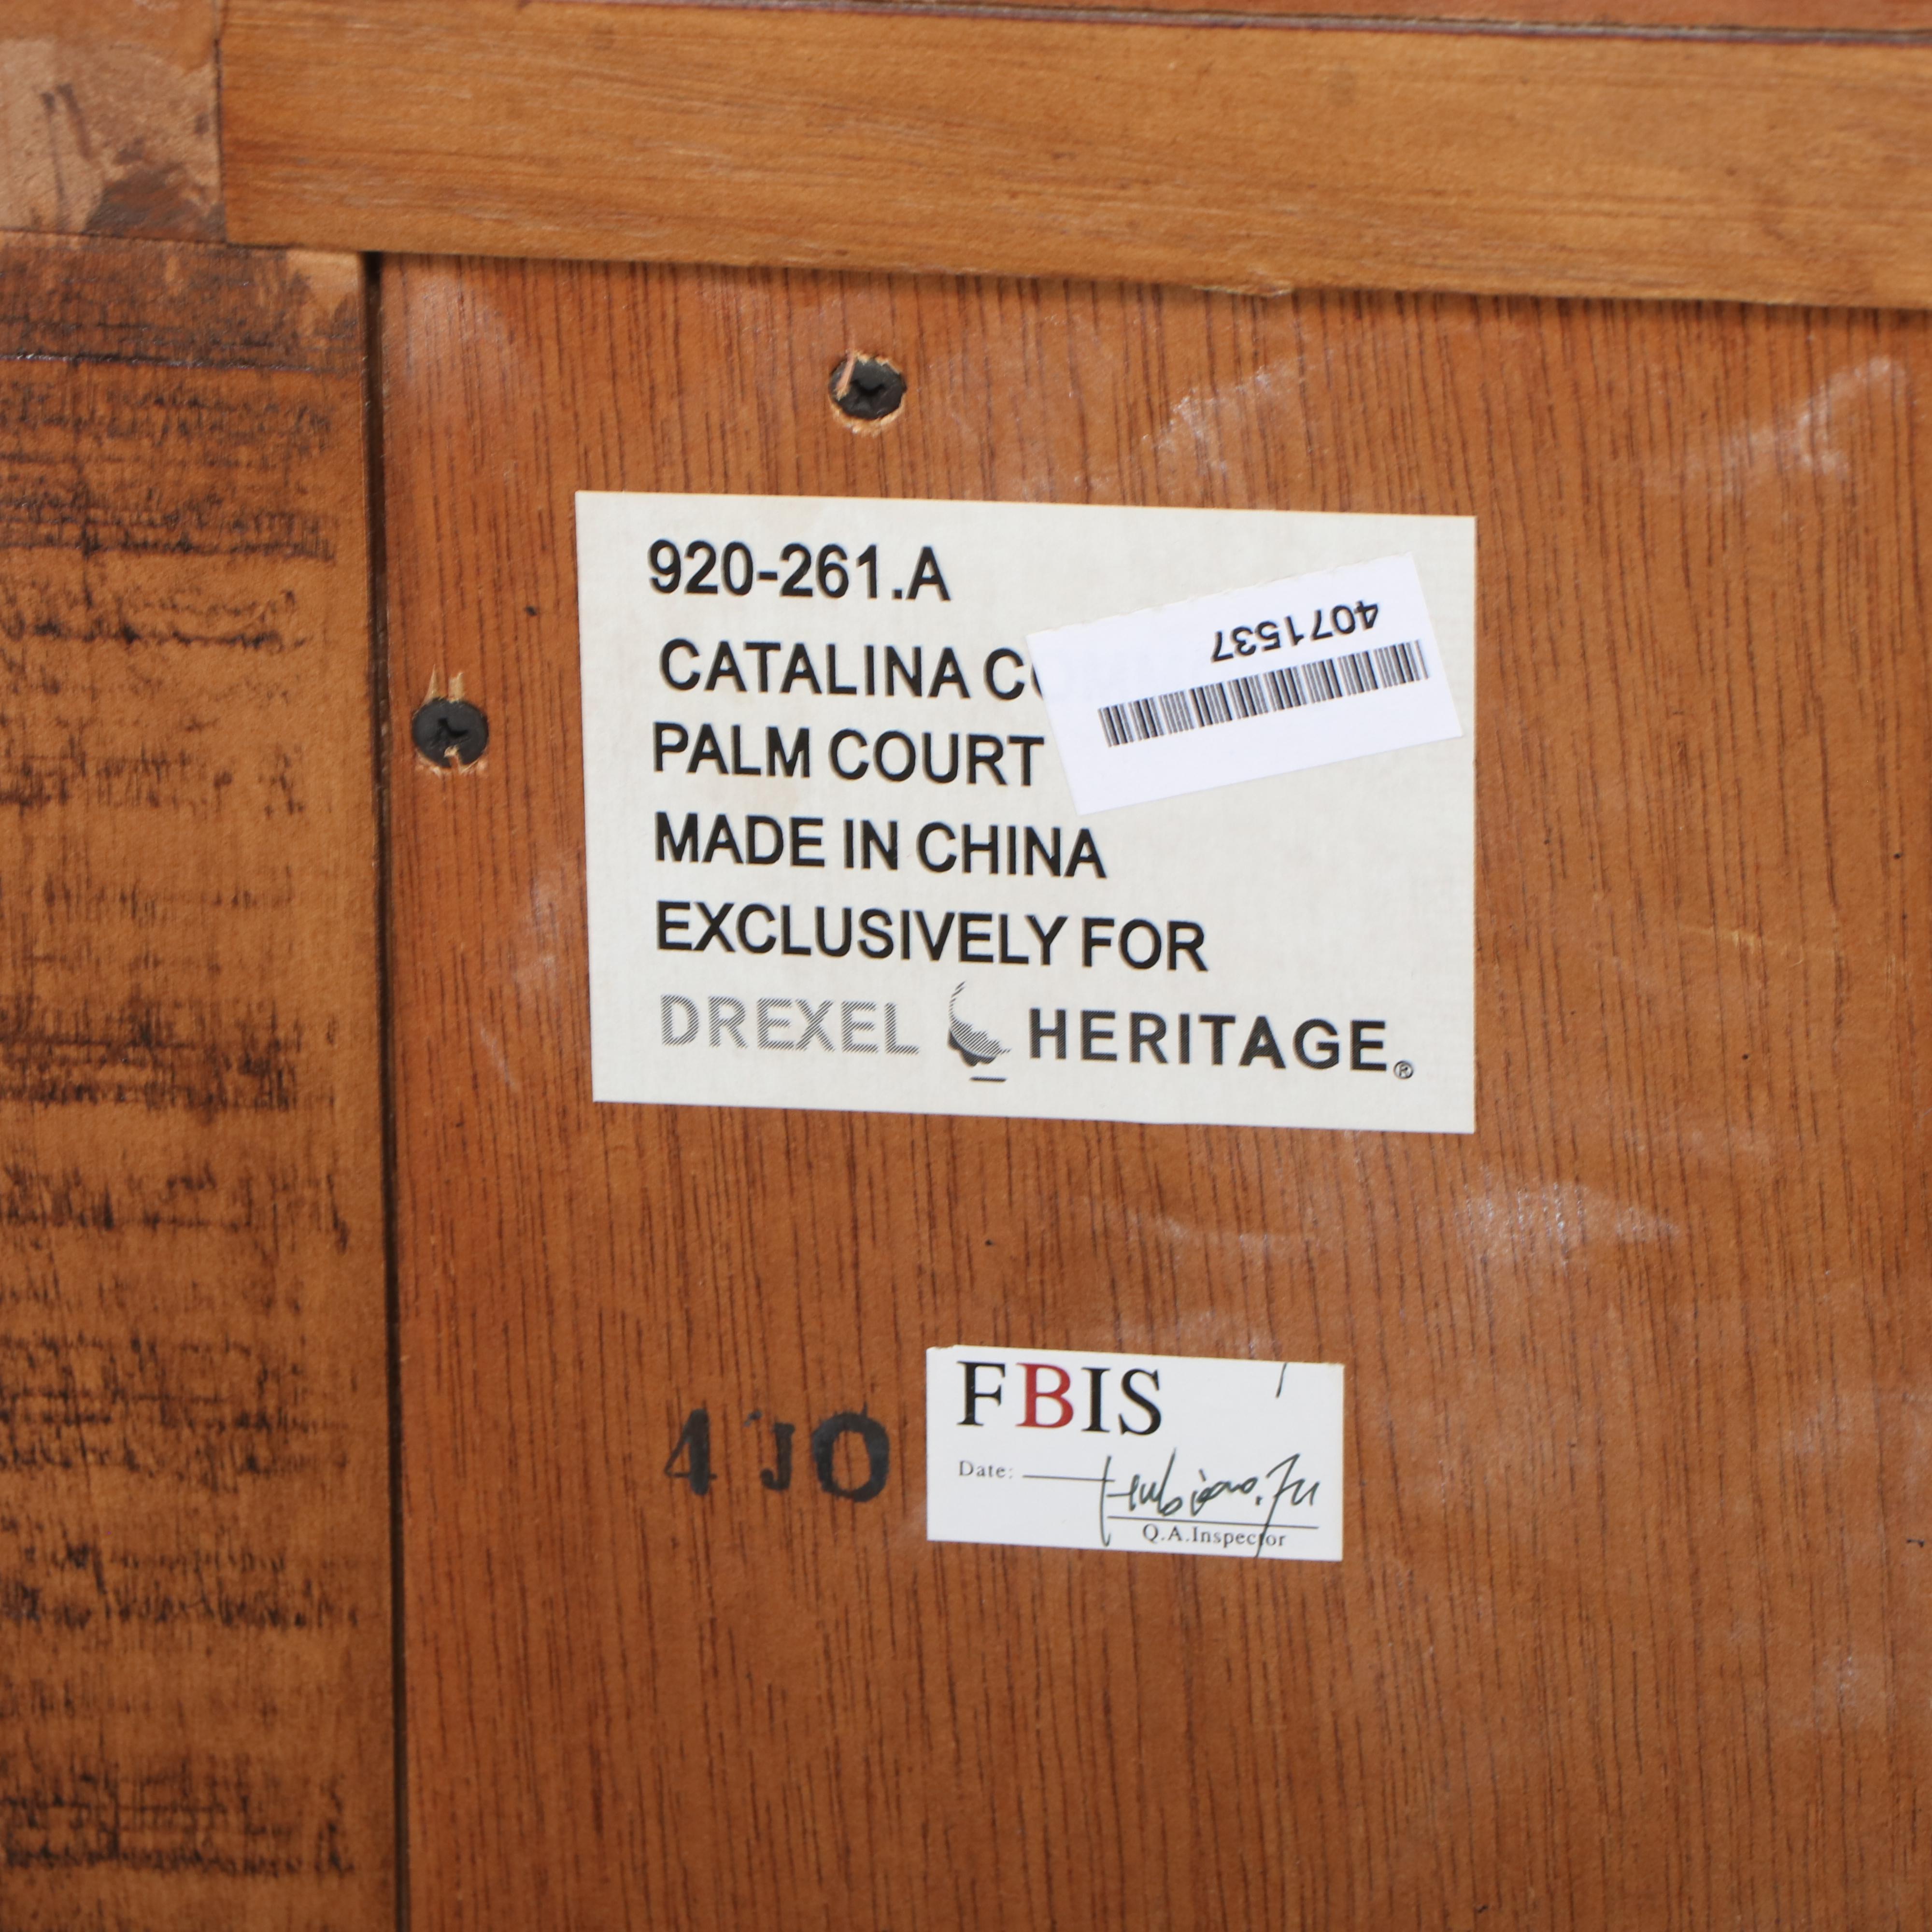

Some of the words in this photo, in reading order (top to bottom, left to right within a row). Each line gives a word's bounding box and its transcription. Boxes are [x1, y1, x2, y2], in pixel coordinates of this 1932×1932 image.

[648, 539, 951, 601] 920-261.A
[1210, 599, 1380, 663] 4071537
[660, 638, 970, 699] CATALINA
[653, 722, 810, 779] PALM
[828, 728, 1045, 787] COURT
[655, 811, 825, 868] MADE
[844, 819, 898, 871] IN
[916, 822, 1107, 879] CHINA
[656, 900, 1068, 966] EXCLUSIVELY
[1082, 917, 1208, 972] FOR
[660, 994, 920, 1056] DREXEL
[956, 1360, 1163, 1435] FBIS
[959, 1460, 1014, 1479] Date:
